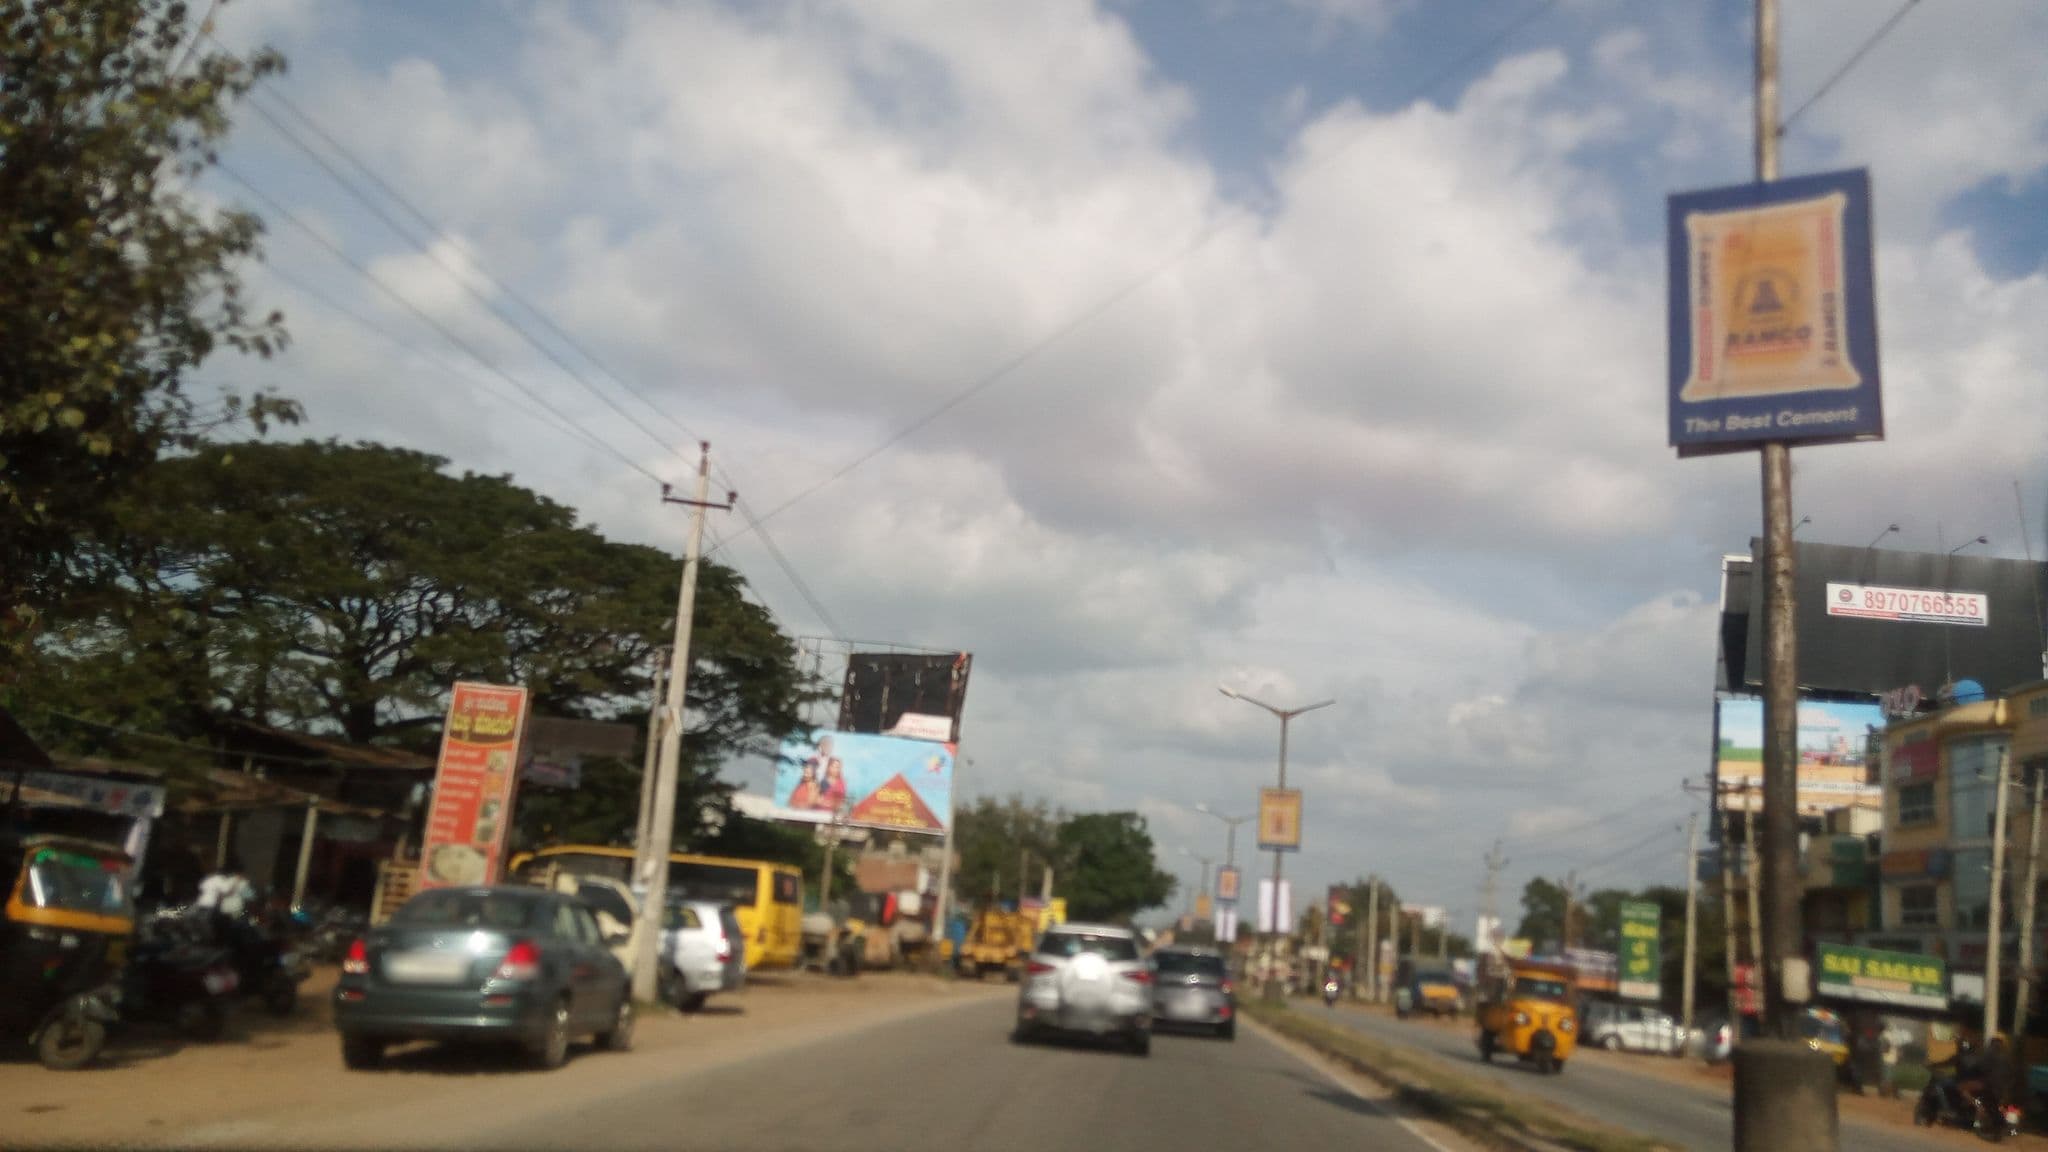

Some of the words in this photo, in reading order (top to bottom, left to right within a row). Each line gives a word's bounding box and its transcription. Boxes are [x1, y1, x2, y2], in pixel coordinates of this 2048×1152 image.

[1727, 325, 1811, 346] RAMCO
[1685, 417, 1720, 433] The
[1725, 413, 1770, 432] Best
[1776, 407, 1858, 427] Cement
[1864, 590, 1979, 617] 8970766555
